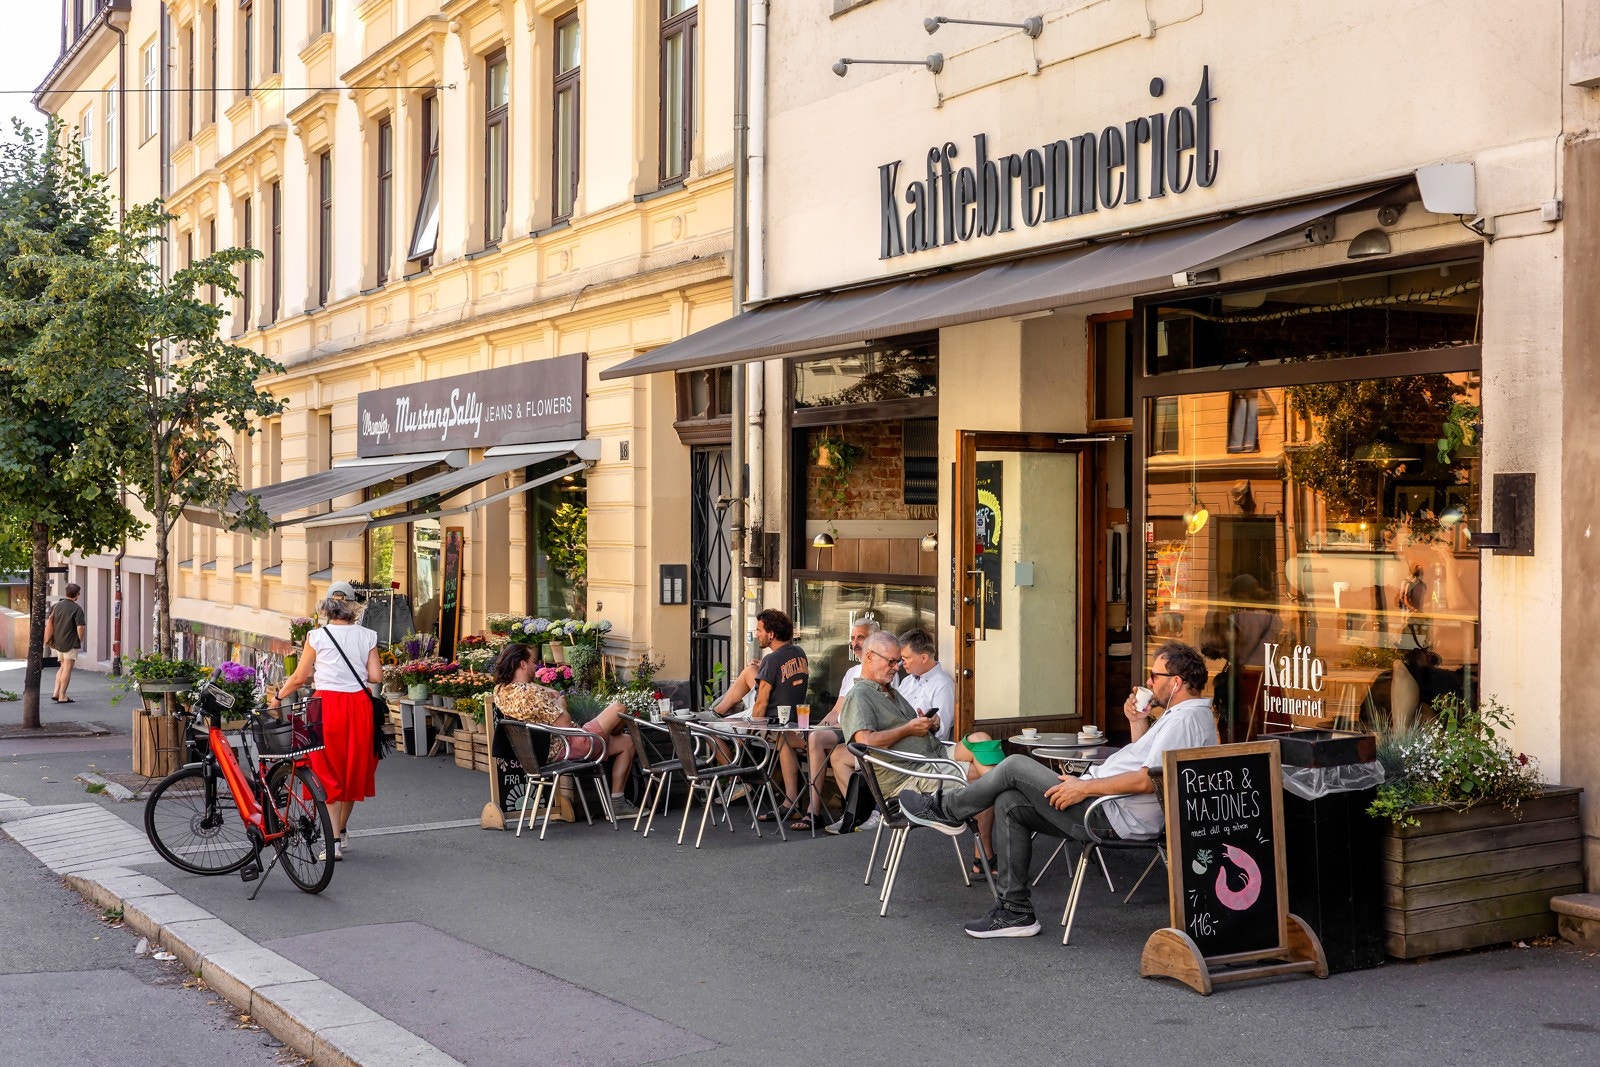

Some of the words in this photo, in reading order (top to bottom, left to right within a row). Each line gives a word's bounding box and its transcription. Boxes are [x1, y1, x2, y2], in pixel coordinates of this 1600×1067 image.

[878, 64, 1218, 260] Kaffebrenneriet
[485, 403, 513, 423] JEANS
[516, 404, 522, 419] &
[526, 395, 572, 417] FLOWERS
[1263, 642, 1323, 692] Kaffe
[1263, 689, 1323, 719] brenneriet
[504, 774, 520, 786] FRA
[1181, 768, 1235, 794] REKER
[1241, 767, 1252, 789] &
[1186, 790, 1260, 821] MAJONES
[1191, 827, 1206, 837] med
[1210, 825, 1220, 835] dill
[1223, 826, 1230, 835] og
